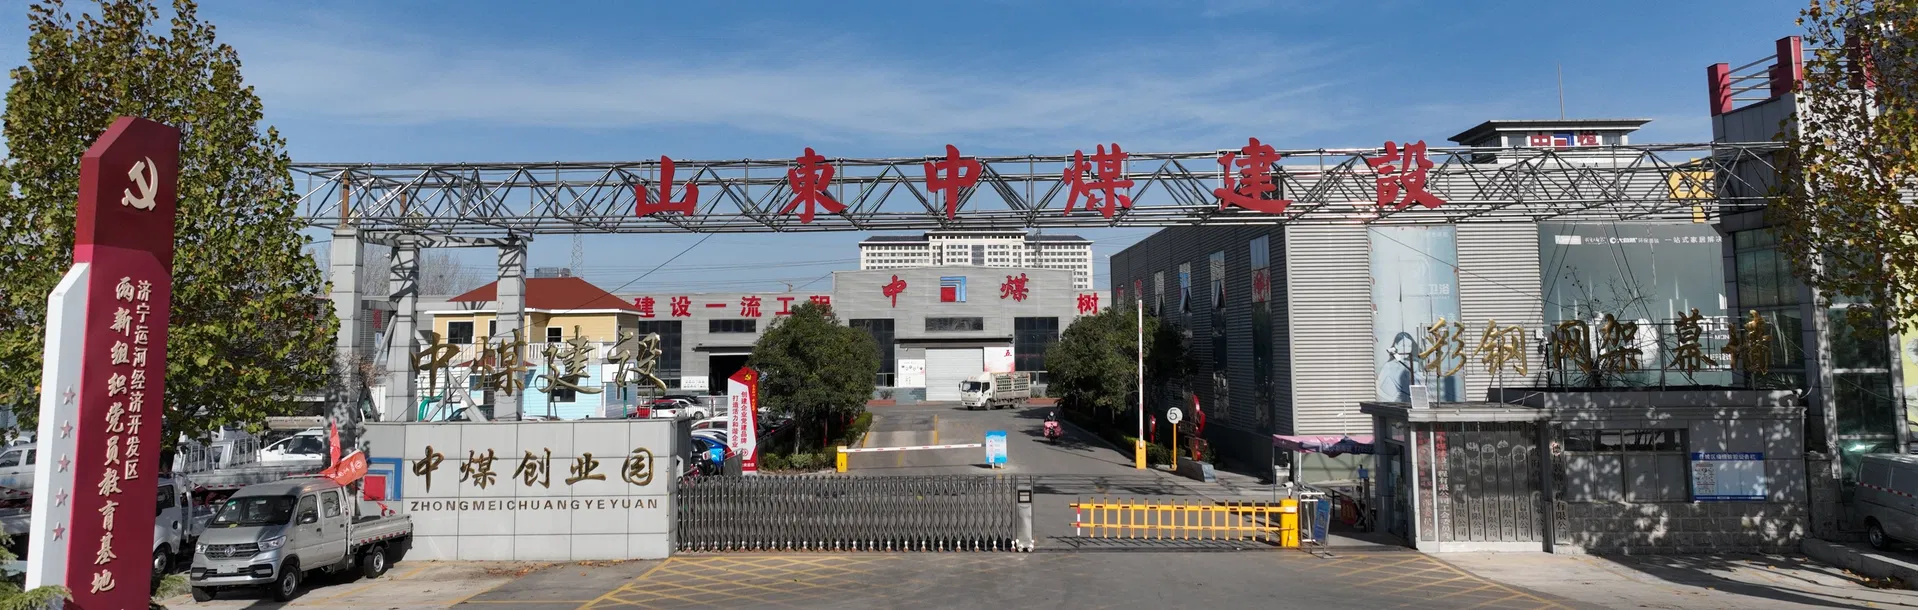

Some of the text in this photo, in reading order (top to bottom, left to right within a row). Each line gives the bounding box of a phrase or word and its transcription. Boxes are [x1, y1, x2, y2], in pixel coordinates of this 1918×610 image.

[1077, 292, 1099, 315] 树
[124, 279, 152, 480] 济宁运河经济开发区
[411, 325, 667, 397] 中煤建设
[91, 276, 135, 594] 两新组织党员教育基地
[1169, 409, 1178, 421] 5
[412, 445, 654, 493] 中煤创业园
[411, 499, 658, 512] ZHONGMEICHUANGYEYUAN
